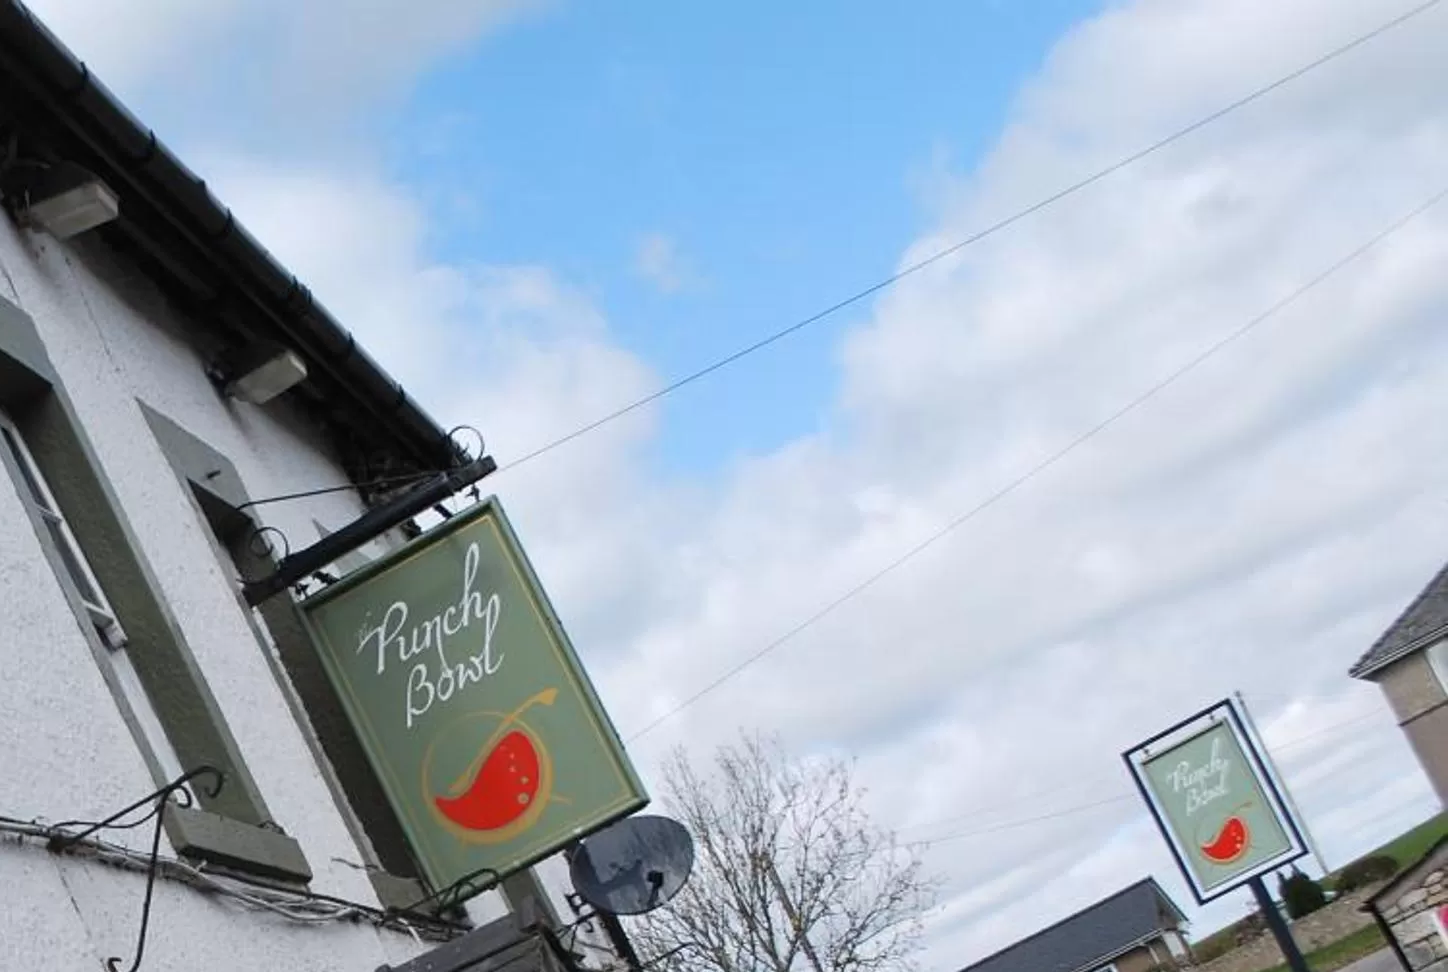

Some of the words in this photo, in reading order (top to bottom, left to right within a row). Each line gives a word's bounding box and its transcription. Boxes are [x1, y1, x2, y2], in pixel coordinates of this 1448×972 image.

[356, 542, 491, 675] Punch
[405, 594, 505, 728] Bowl
[1166, 738, 1224, 792] Punch
